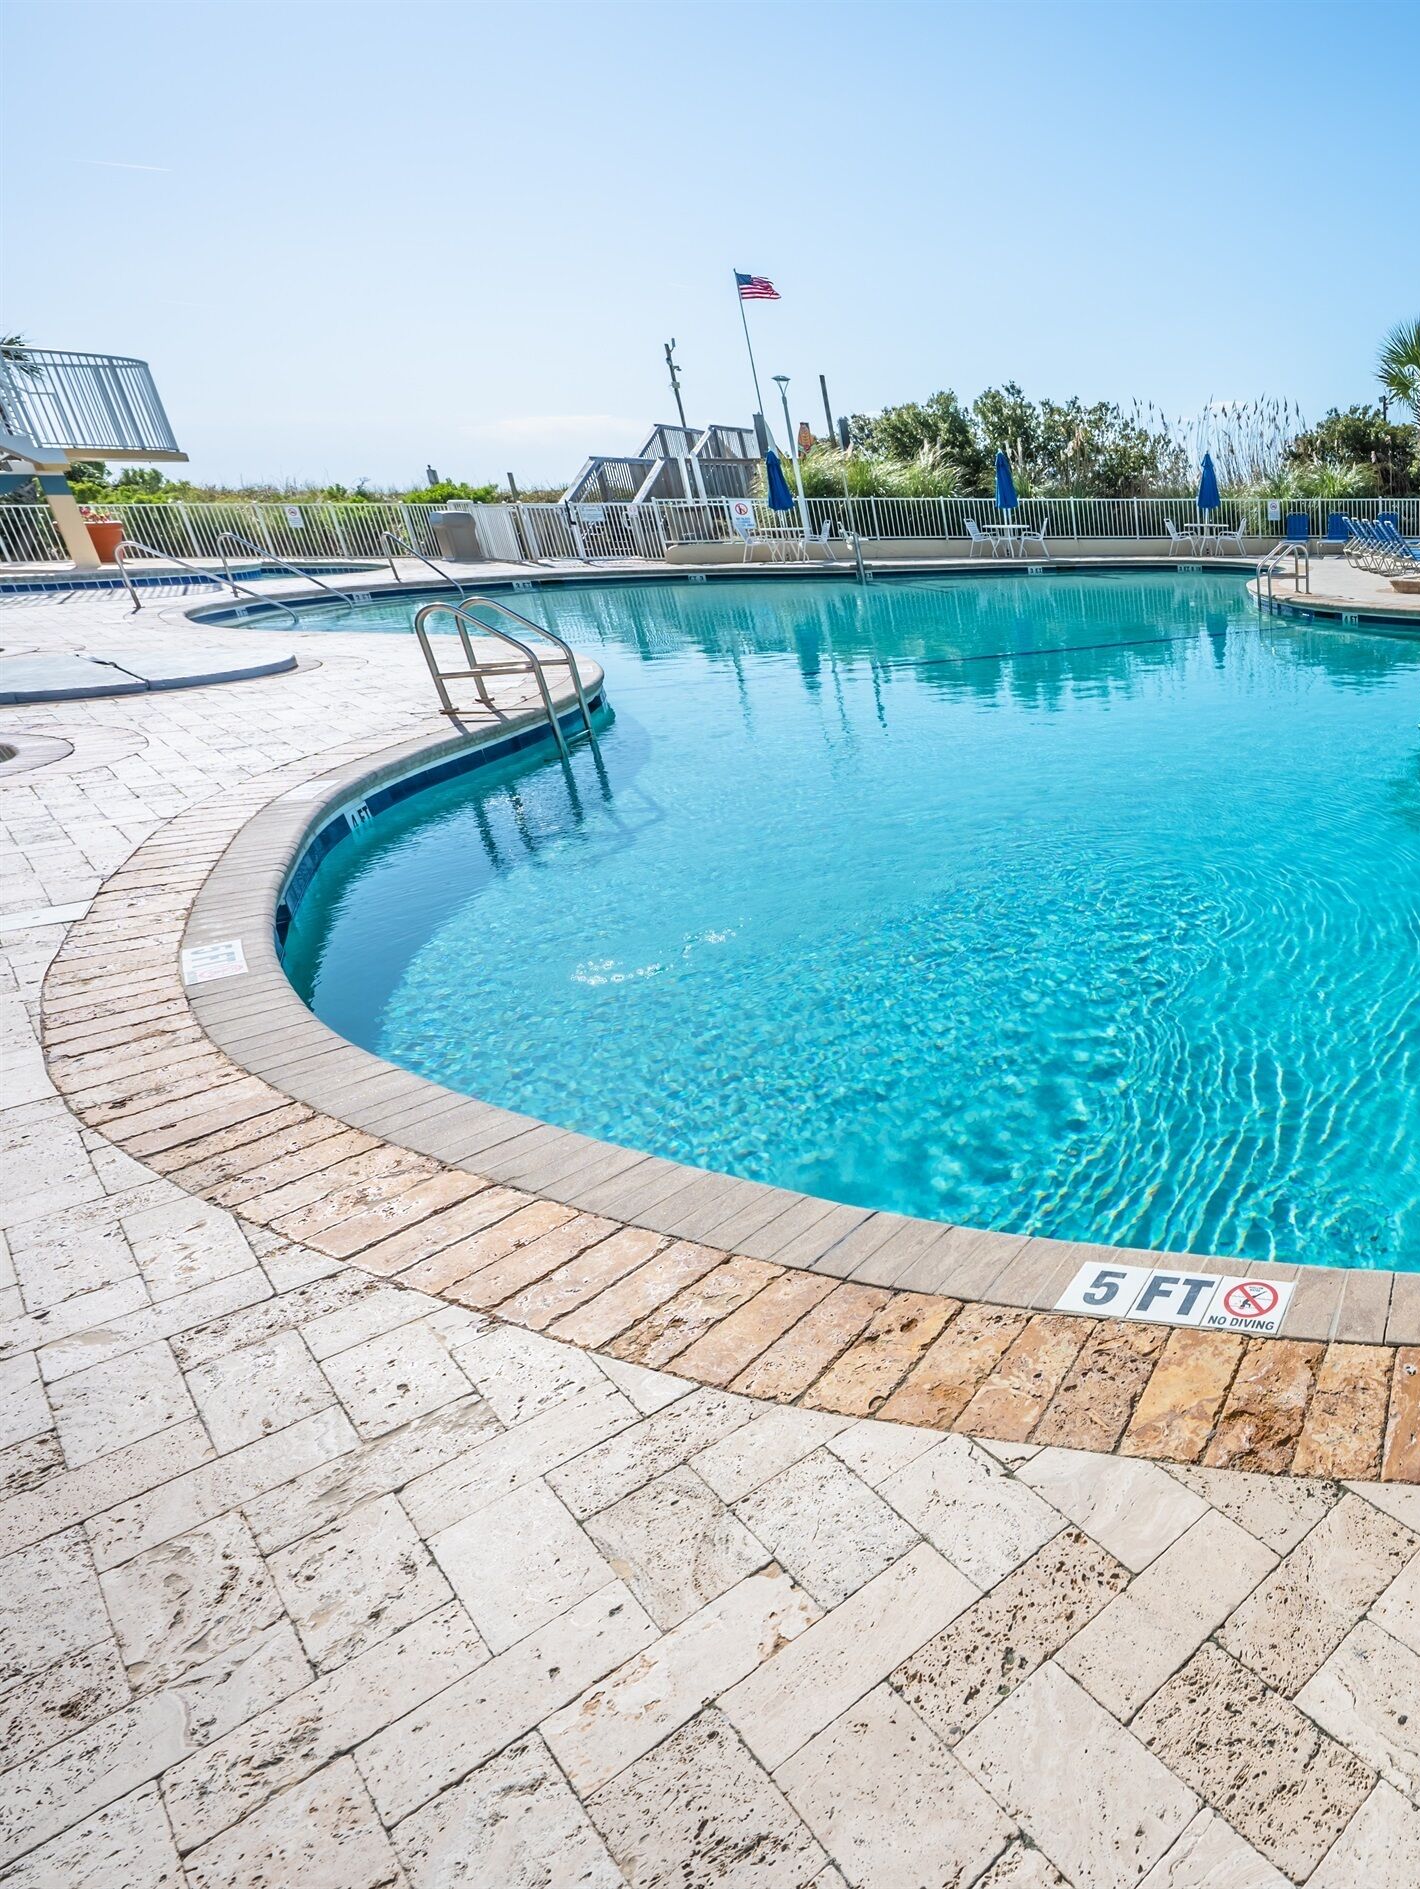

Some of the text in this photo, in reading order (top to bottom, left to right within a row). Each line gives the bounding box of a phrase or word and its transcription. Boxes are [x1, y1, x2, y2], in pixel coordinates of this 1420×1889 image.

[1082, 1270, 1215, 1316] 5 FT
[1207, 1315, 1275, 1330] NO DIVING
